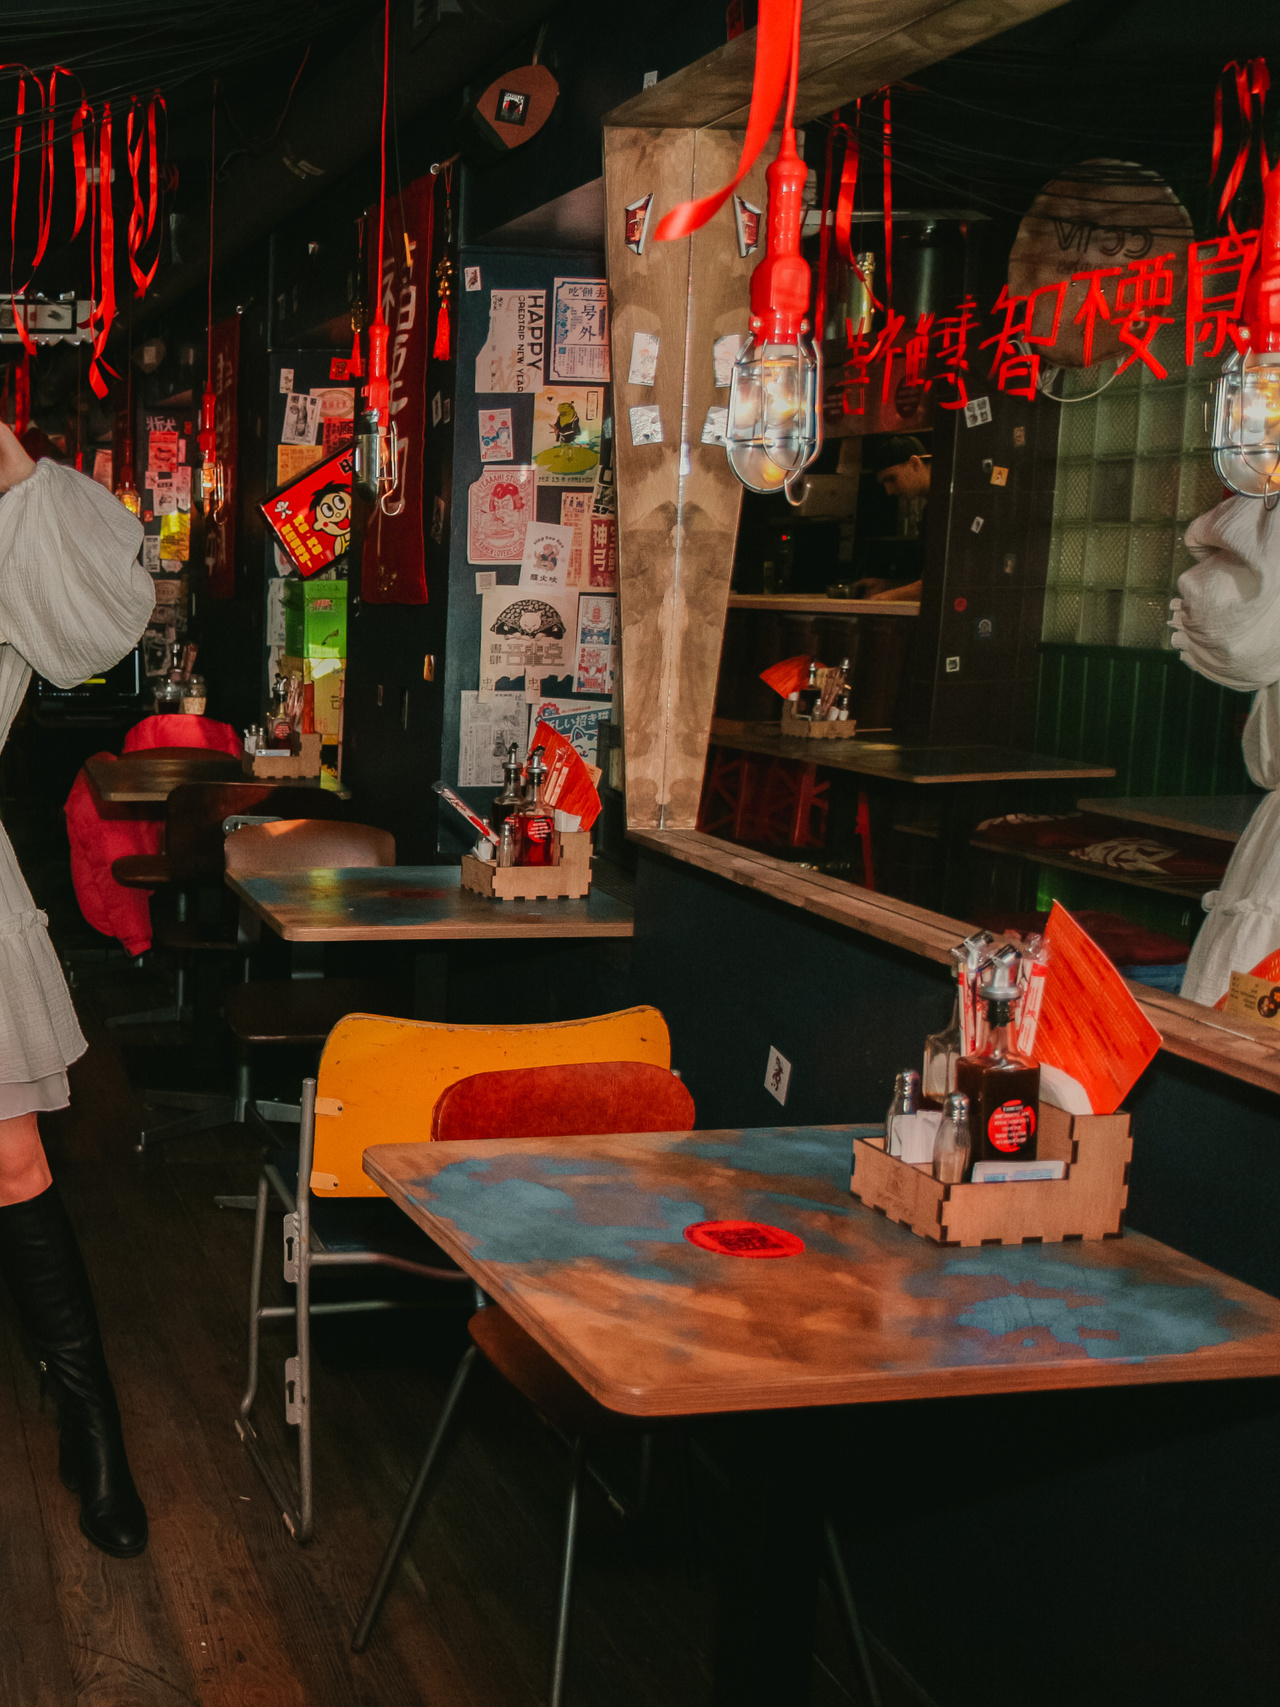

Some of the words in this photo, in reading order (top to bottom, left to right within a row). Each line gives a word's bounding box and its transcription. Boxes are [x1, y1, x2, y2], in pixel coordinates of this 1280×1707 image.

[527, 295, 544, 372] HAPPY
[578, 303, 598, 342] 号外
[516, 343, 525, 364] NEW
[516, 368, 524, 392] YEAR
[493, 545, 512, 557] LOVERS
